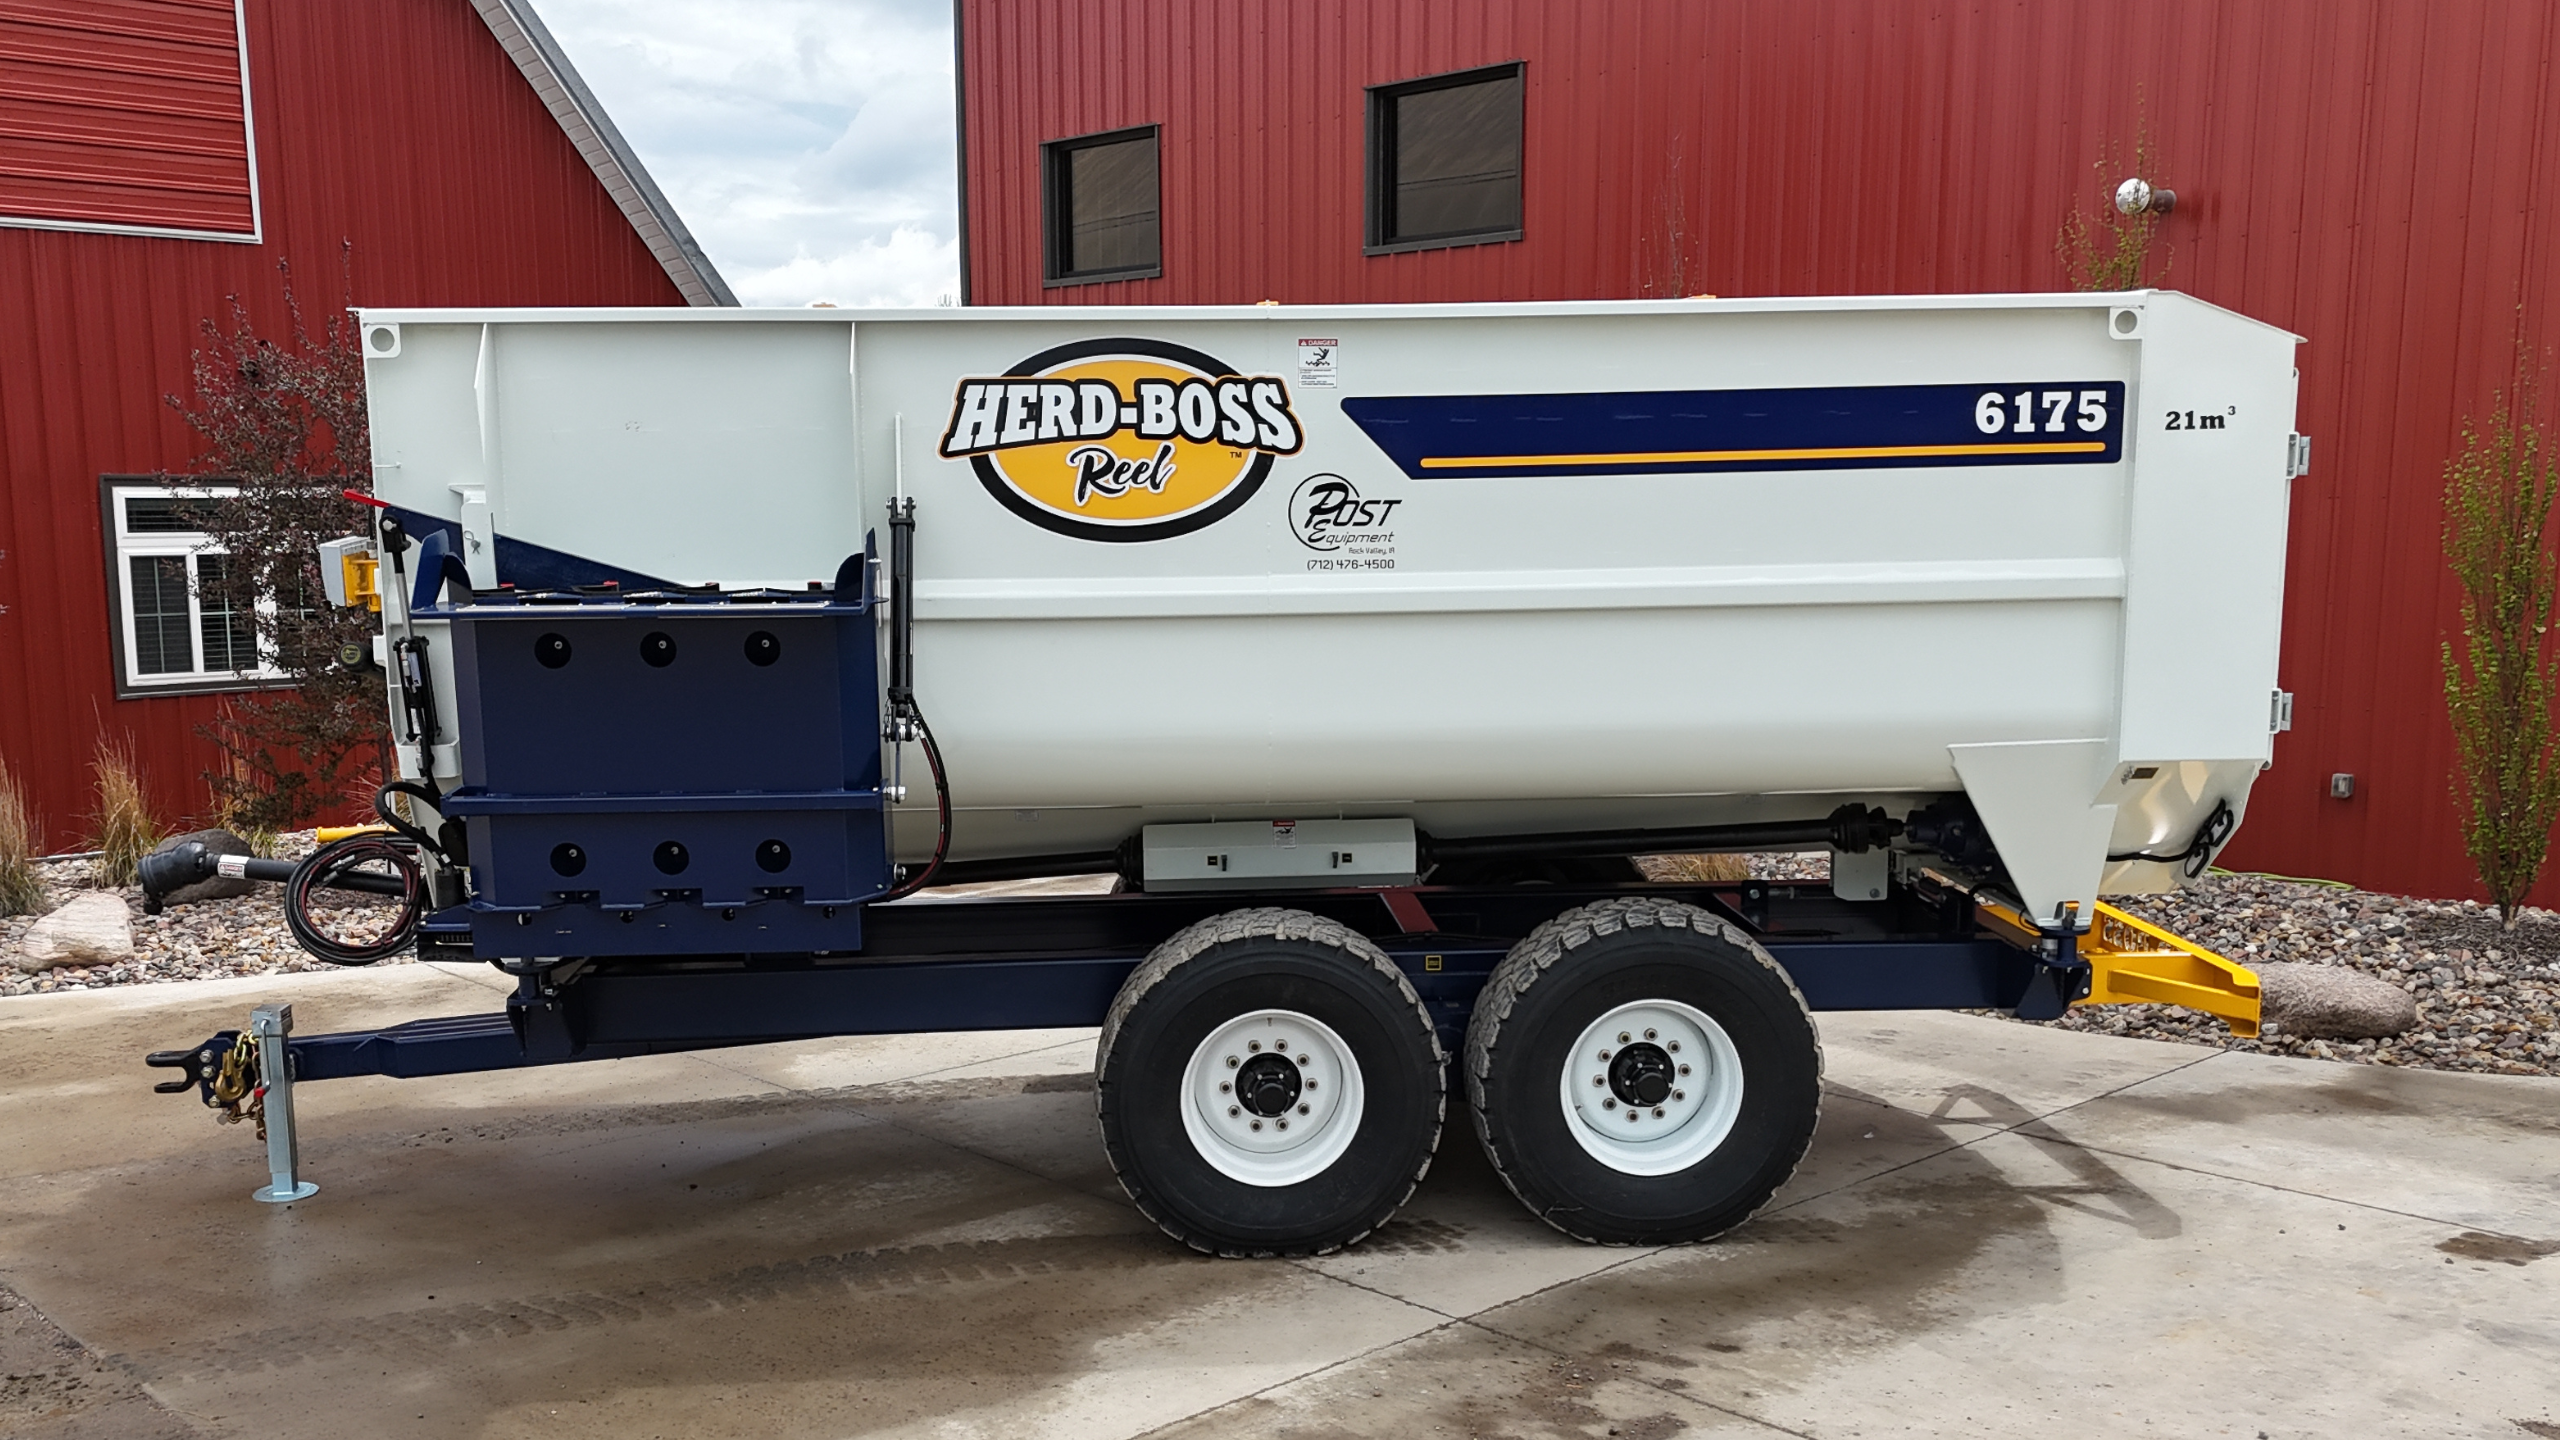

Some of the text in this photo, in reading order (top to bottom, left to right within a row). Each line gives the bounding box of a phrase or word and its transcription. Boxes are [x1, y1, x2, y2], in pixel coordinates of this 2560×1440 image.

[948, 382, 1298, 452] HERD-BOSS
[1975, 390, 2107, 434] 6175
[1069, 445, 1173, 503] Reel
[1307, 518, 1395, 546] Equipment
[1306, 559, 1395, 571] (712) 476-4500
